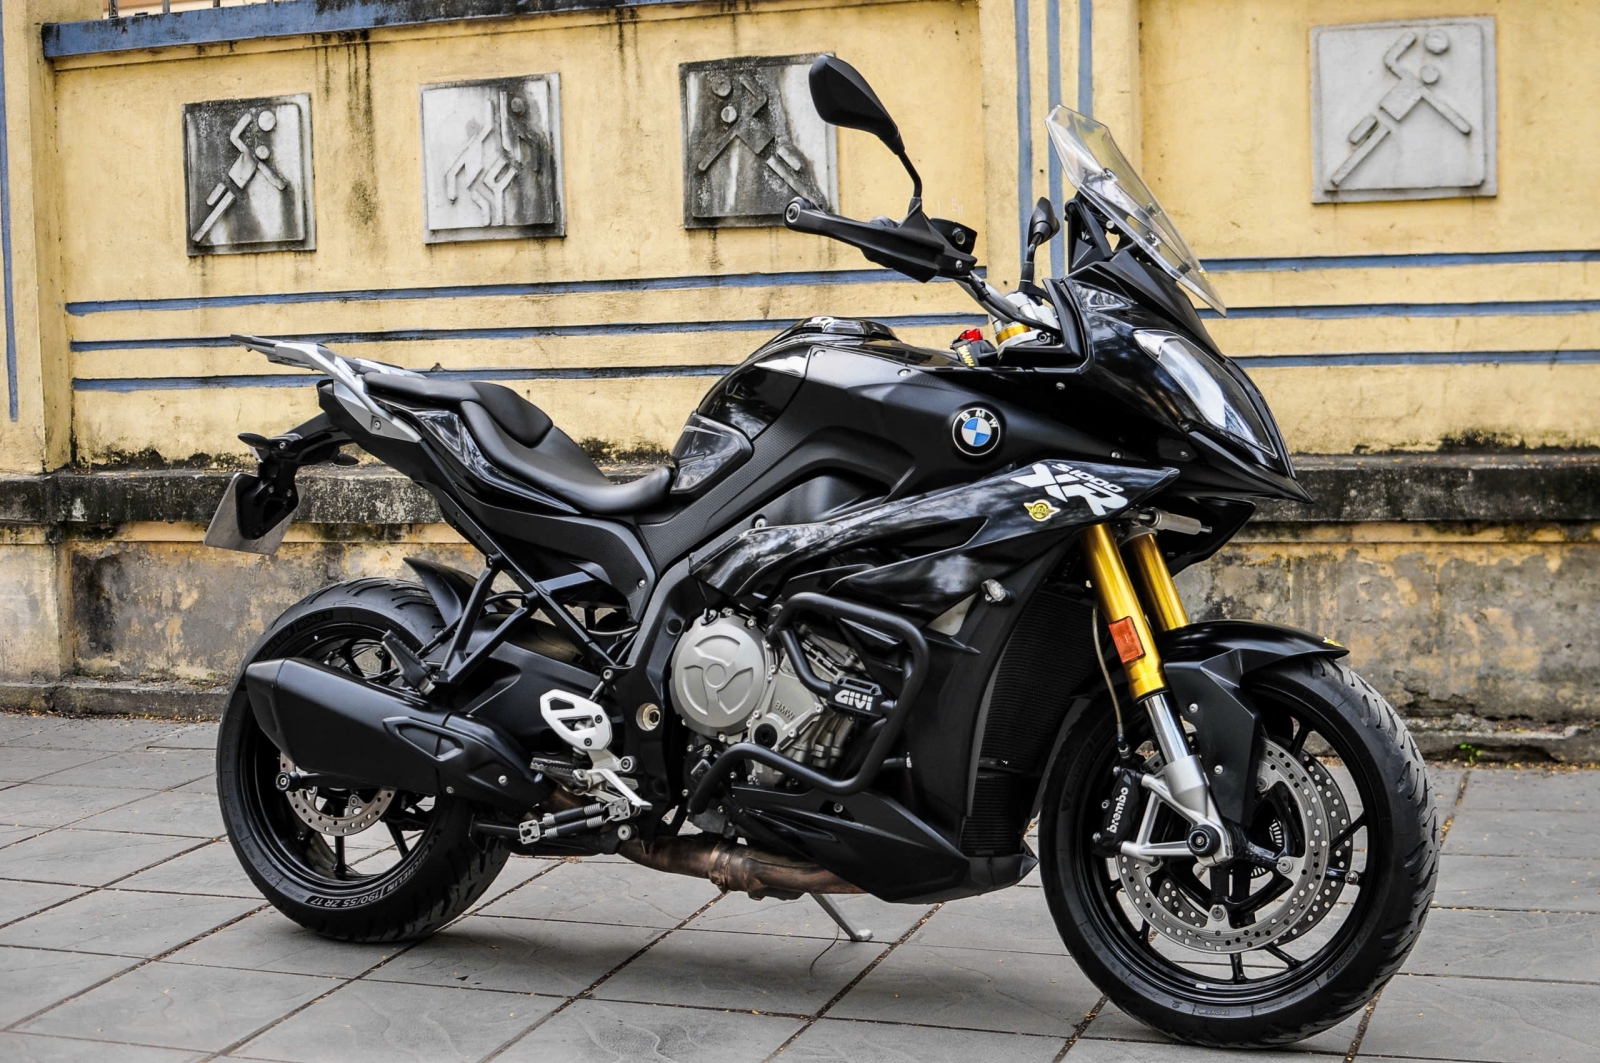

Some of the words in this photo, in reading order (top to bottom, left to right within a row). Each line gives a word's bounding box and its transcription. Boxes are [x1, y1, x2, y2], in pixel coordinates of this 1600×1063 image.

[959, 409, 999, 428] BMW
[1051, 463, 1073, 473] S
[1069, 469, 1125, 493] 1000
[1010, 462, 1128, 517] XR
[774, 700, 796, 720] BMW
[834, 689, 874, 711] GIVI
[1106, 786, 1129, 834] brembo
[386, 847, 430, 892] MICHELIN
[309, 897, 323, 905] 17
[324, 898, 341, 908] ZR
[341, 891, 380, 908] 190/55
